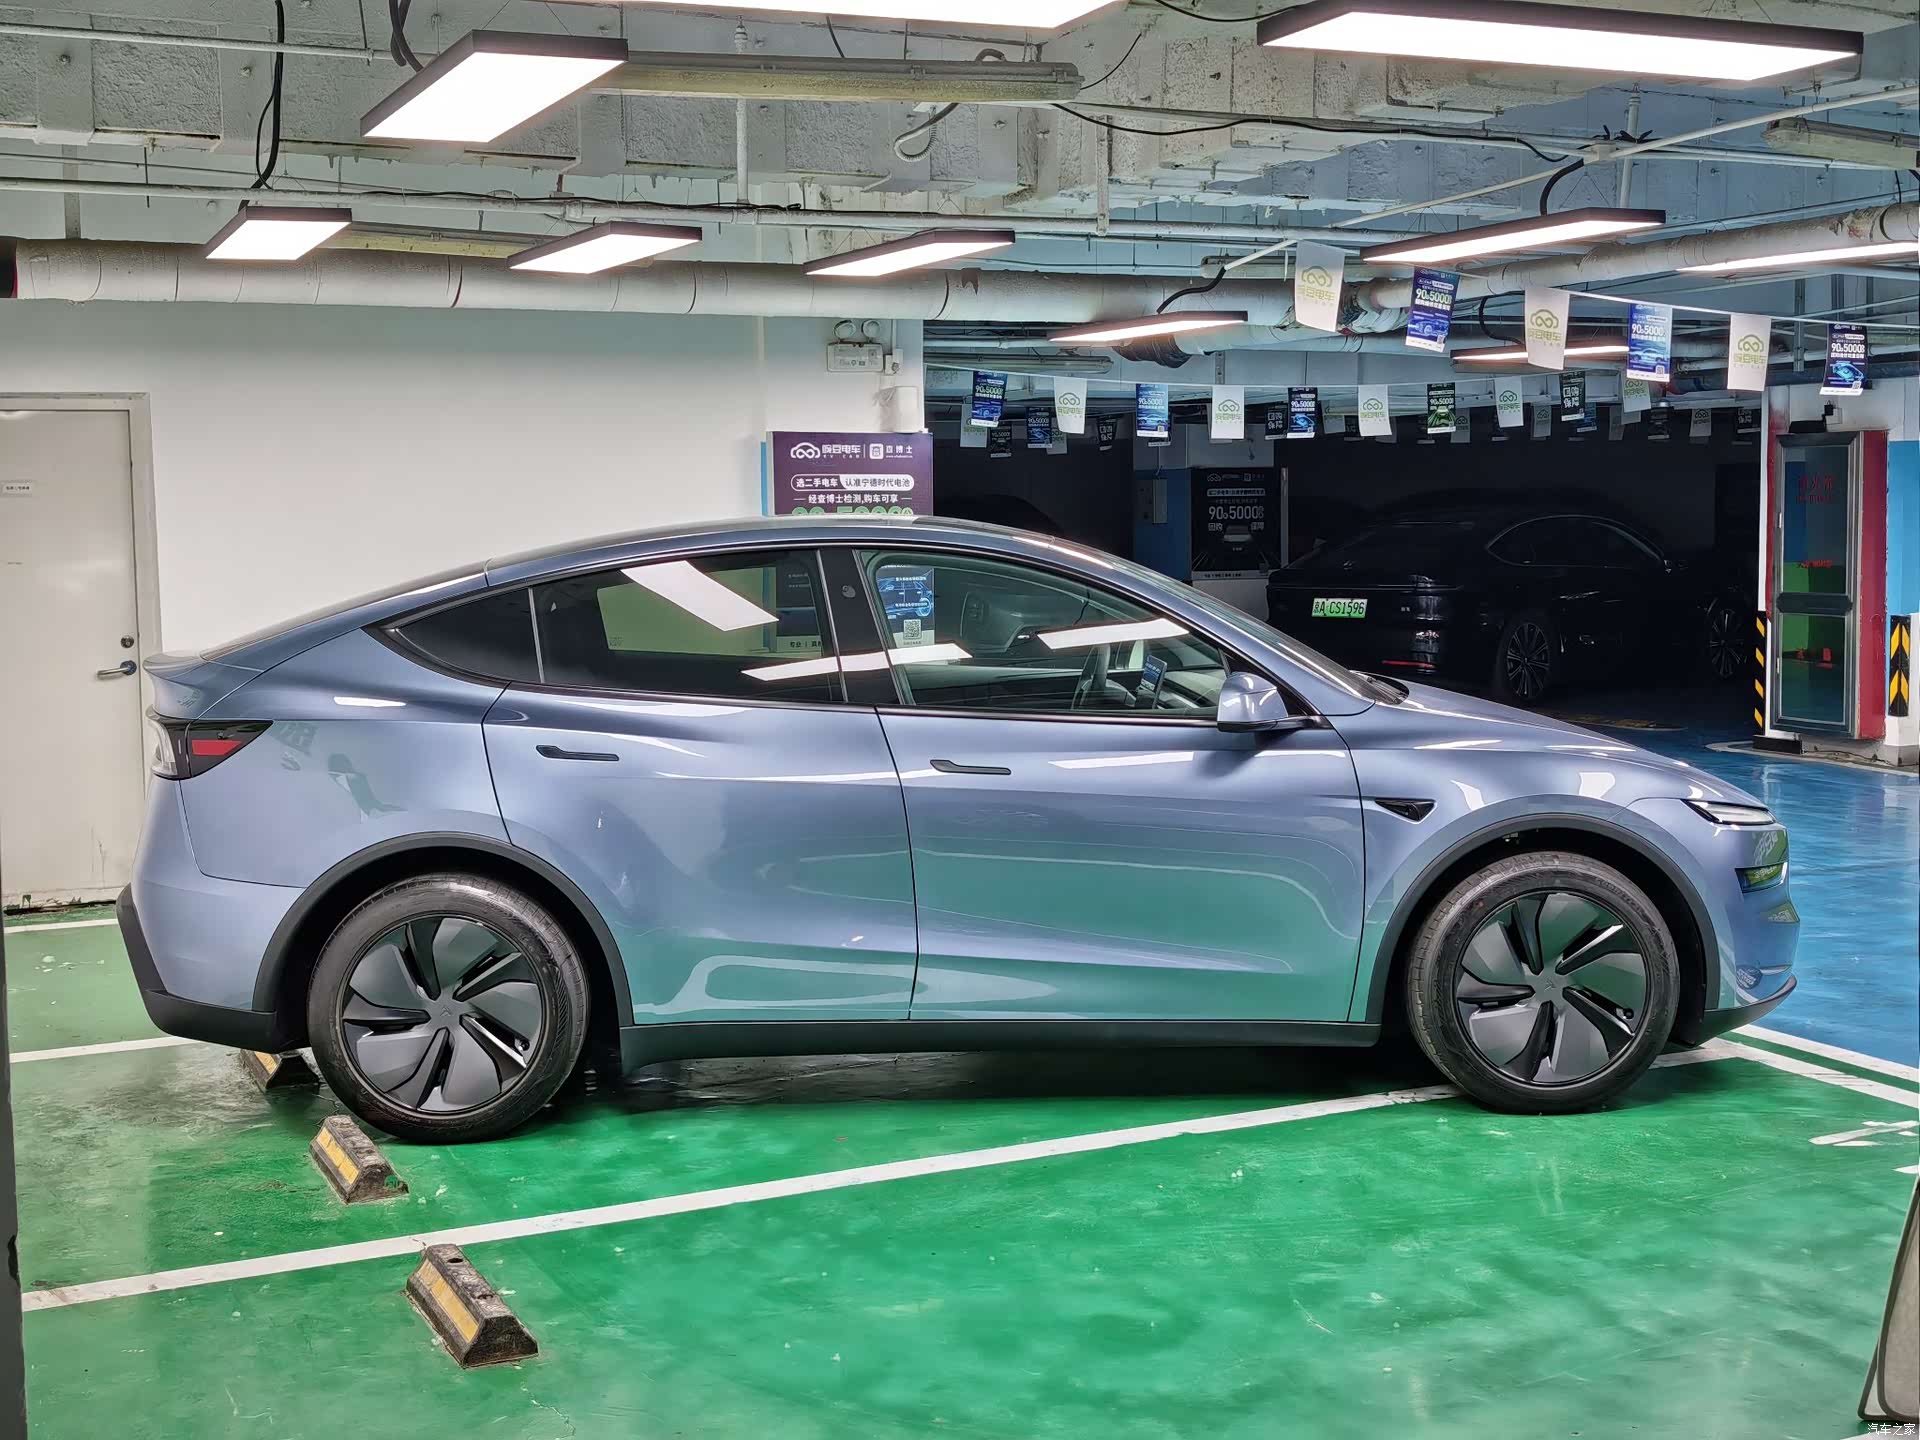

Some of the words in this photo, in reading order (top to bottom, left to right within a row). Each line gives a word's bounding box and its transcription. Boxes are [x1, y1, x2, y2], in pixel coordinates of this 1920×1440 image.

[845, 478, 910, 487] 认准宁德时代电池
